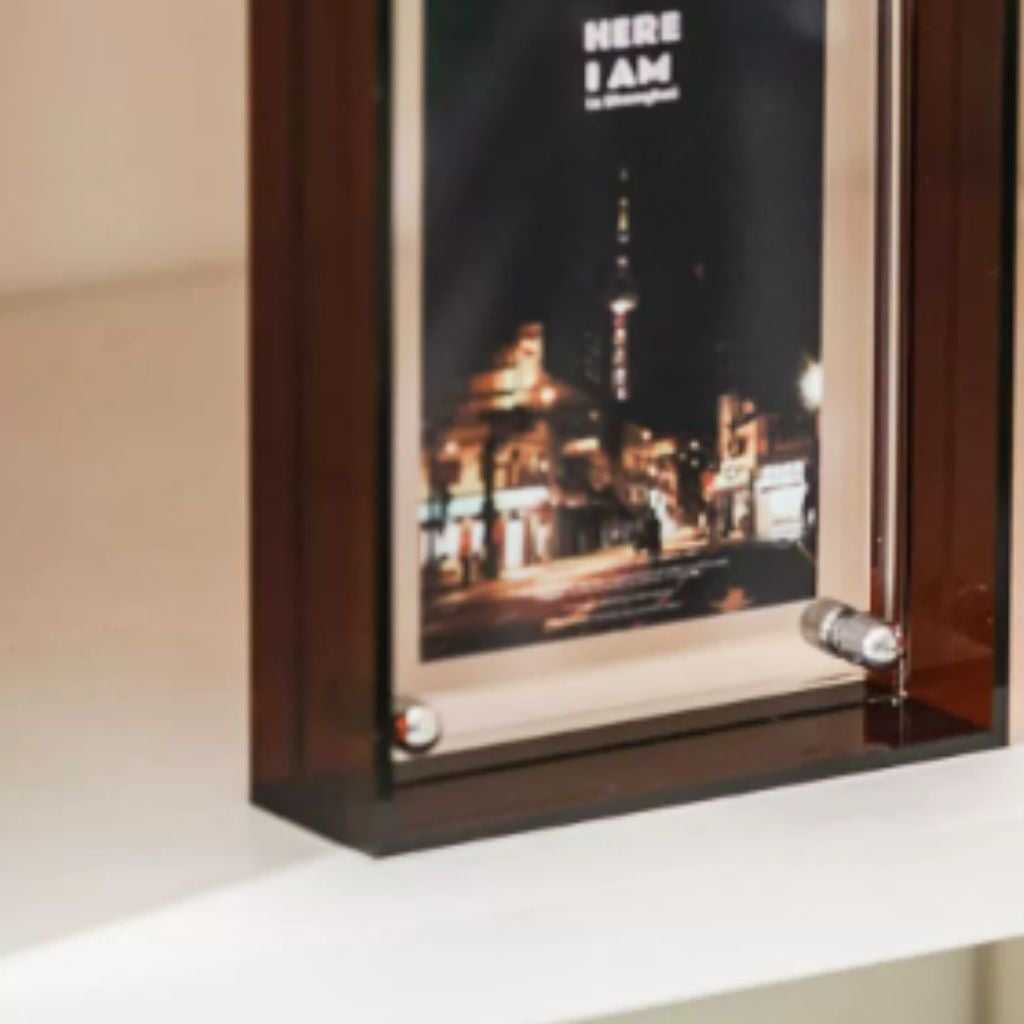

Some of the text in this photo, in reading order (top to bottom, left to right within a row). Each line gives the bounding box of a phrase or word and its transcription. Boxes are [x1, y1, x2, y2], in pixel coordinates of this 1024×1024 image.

[584, 10, 681, 52] HERE
[585, 53, 671, 93] I AM
